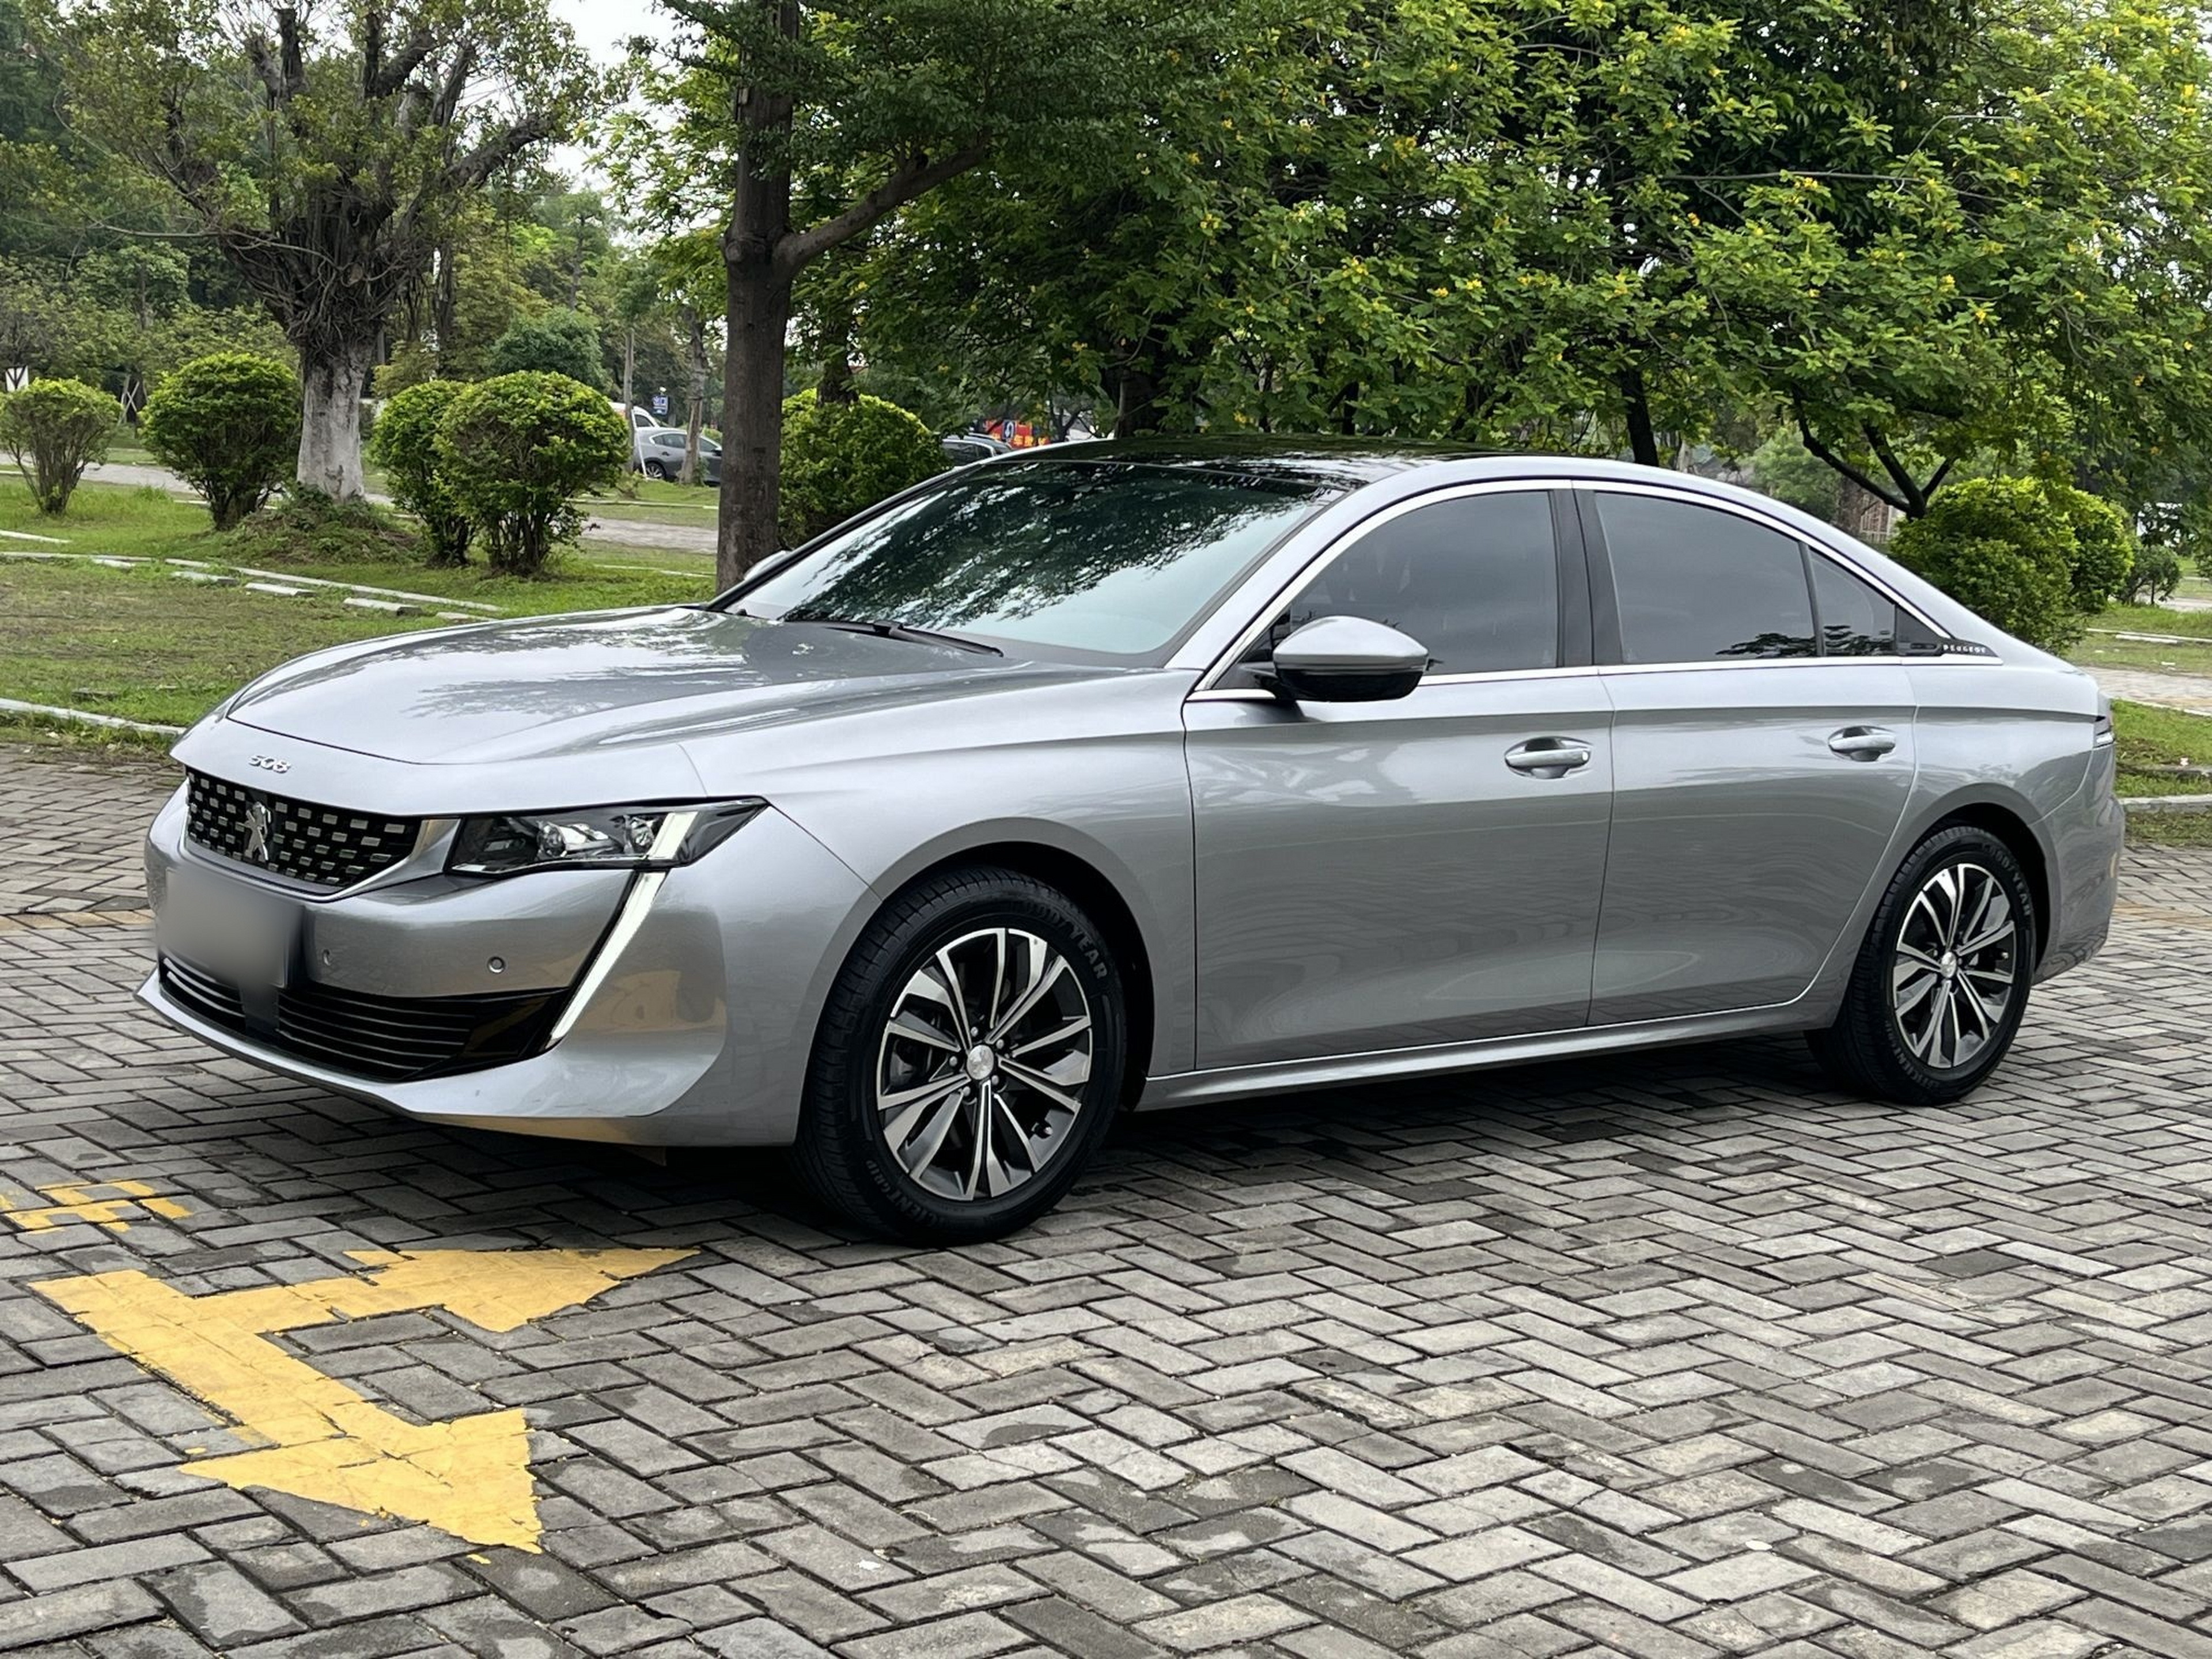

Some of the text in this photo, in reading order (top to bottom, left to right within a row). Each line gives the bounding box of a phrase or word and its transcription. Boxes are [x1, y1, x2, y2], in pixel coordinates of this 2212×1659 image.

[1943, 644, 1986, 653] PEUGEOT
[248, 754, 291, 774] 508
[1013, 902, 1108, 980] OODYEAR
